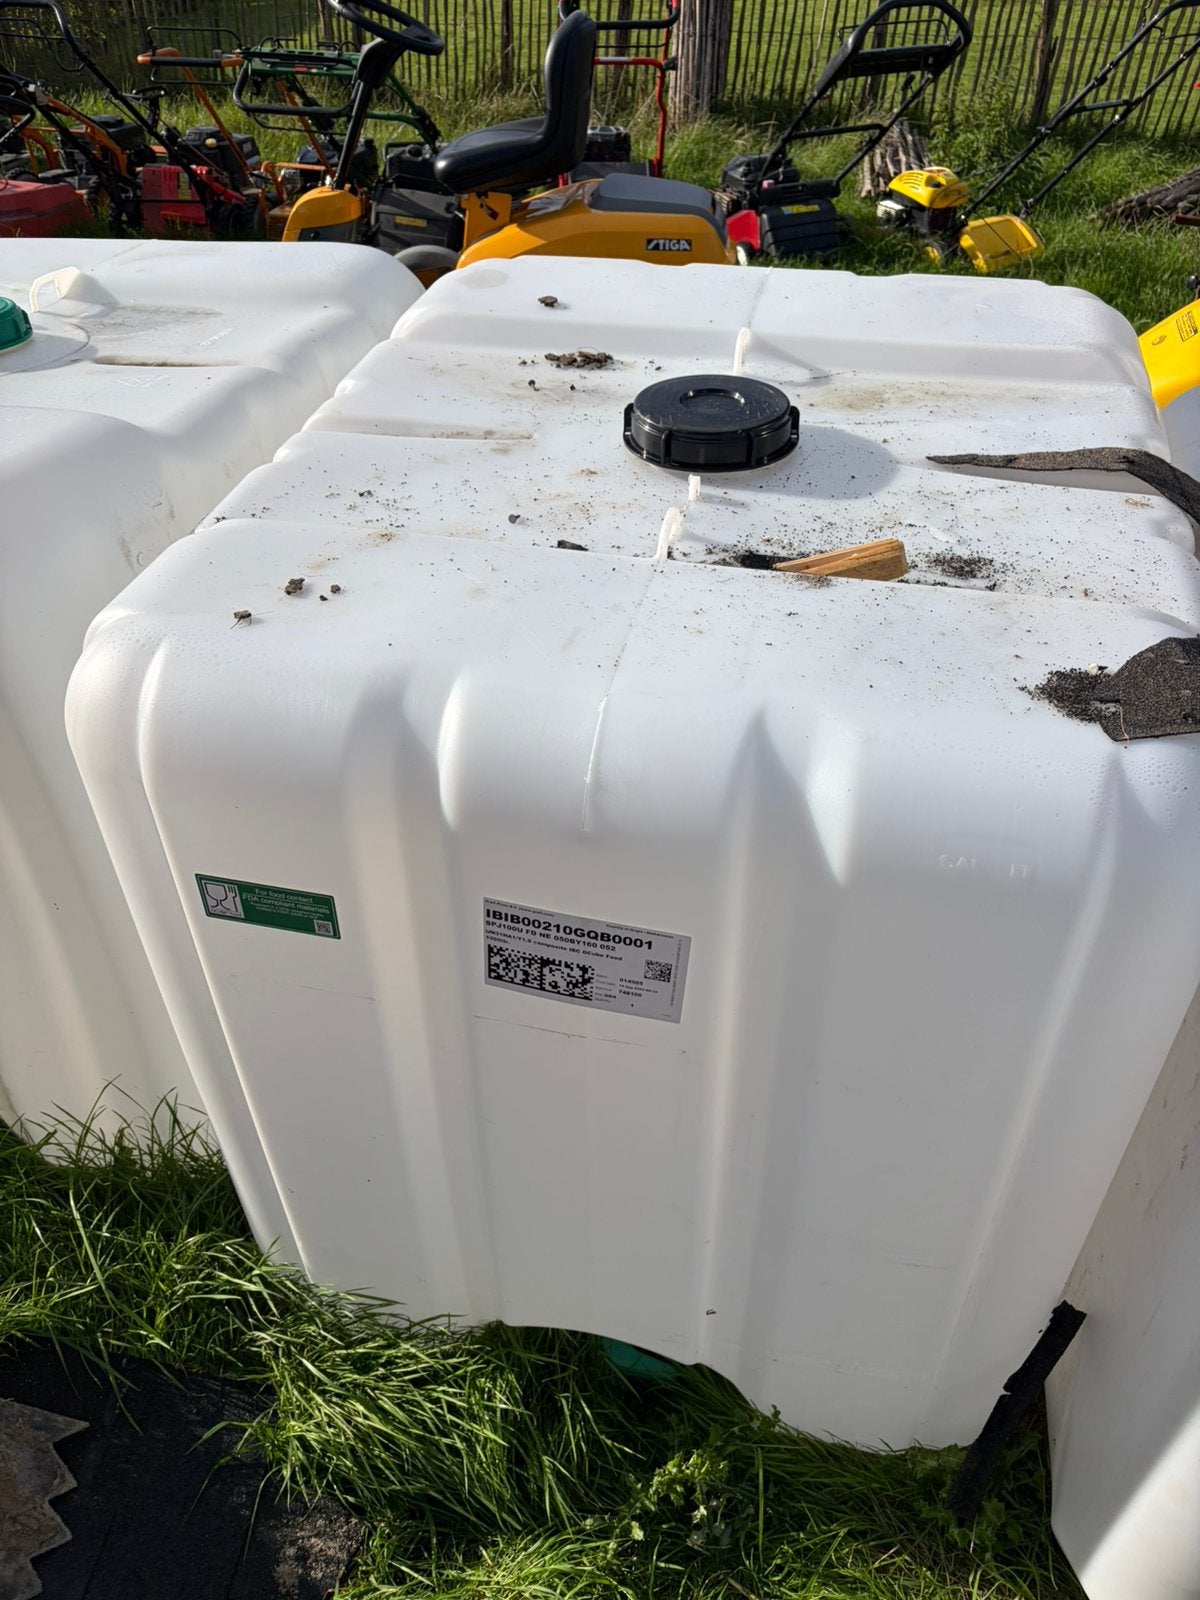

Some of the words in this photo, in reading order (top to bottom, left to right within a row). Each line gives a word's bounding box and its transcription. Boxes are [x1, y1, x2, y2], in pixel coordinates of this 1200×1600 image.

[647, 239, 691, 251] STIGA
[242, 894, 260, 903] FDA
[260, 897, 296, 910] compliant
[296, 903, 331, 915] materials
[255, 888, 268, 896] For
[268, 890, 286, 899] food
[286, 894, 314, 904] contact
[485, 908, 653, 950] IBIB00210GQB0001
[485, 920, 524, 934] SPJ100U
[525, 929, 537, 937] FD
[539, 932, 552, 940] NE
[553, 935, 598, 950] 050BY160
[599, 944, 617, 952] 052
[533, 940, 568, 952] composite
[568, 947, 581, 955] IBC
[605, 954, 623, 962] Food
